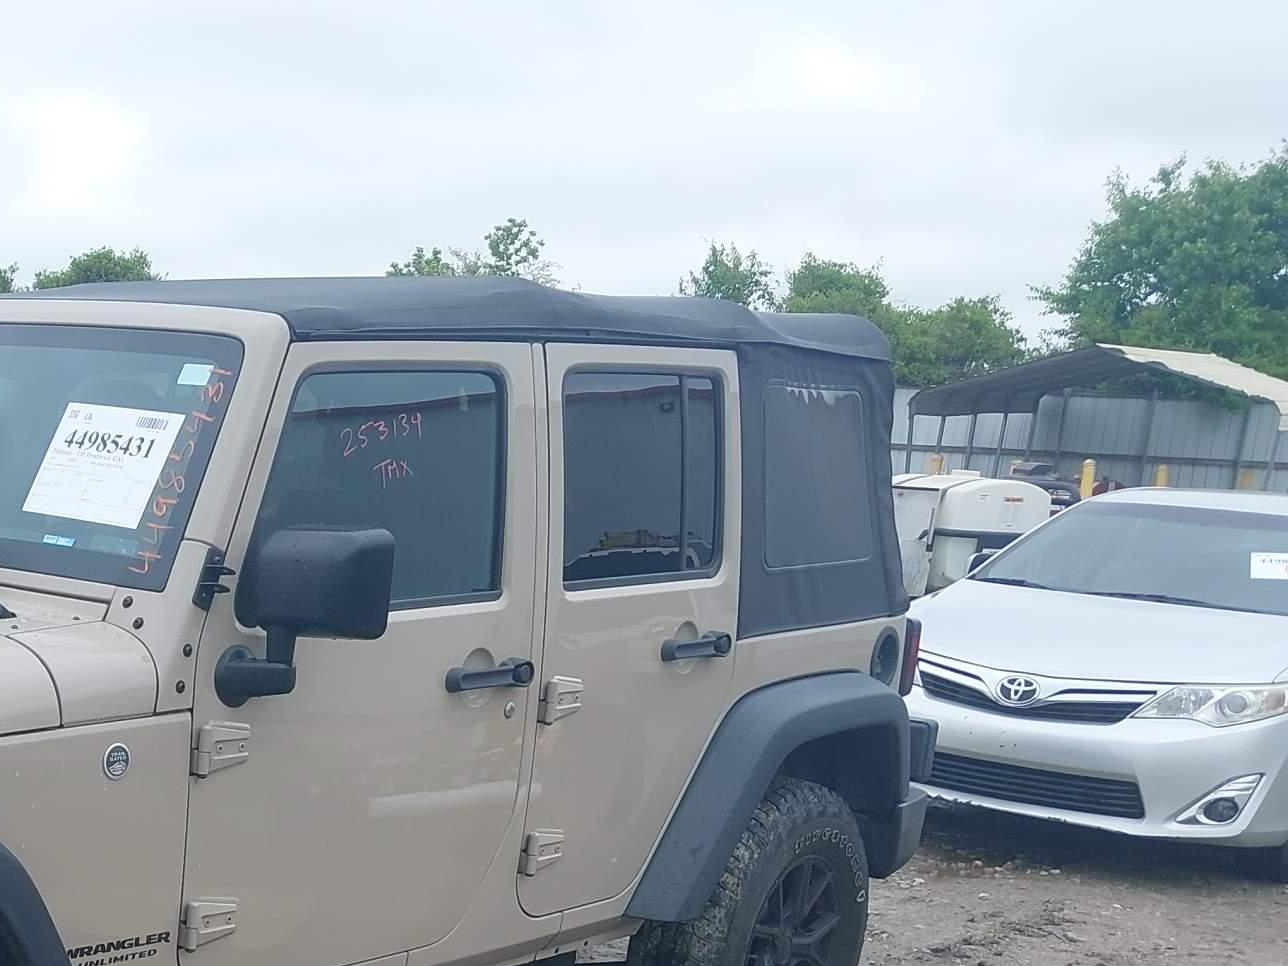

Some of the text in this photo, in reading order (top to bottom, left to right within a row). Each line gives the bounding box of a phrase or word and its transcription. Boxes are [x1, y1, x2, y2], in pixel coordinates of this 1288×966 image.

[63, 424, 156, 458] 44985431
[340, 412, 422, 457] 253134
[128, 366, 233, 574] 44985431
[372, 458, 414, 489] TMX
